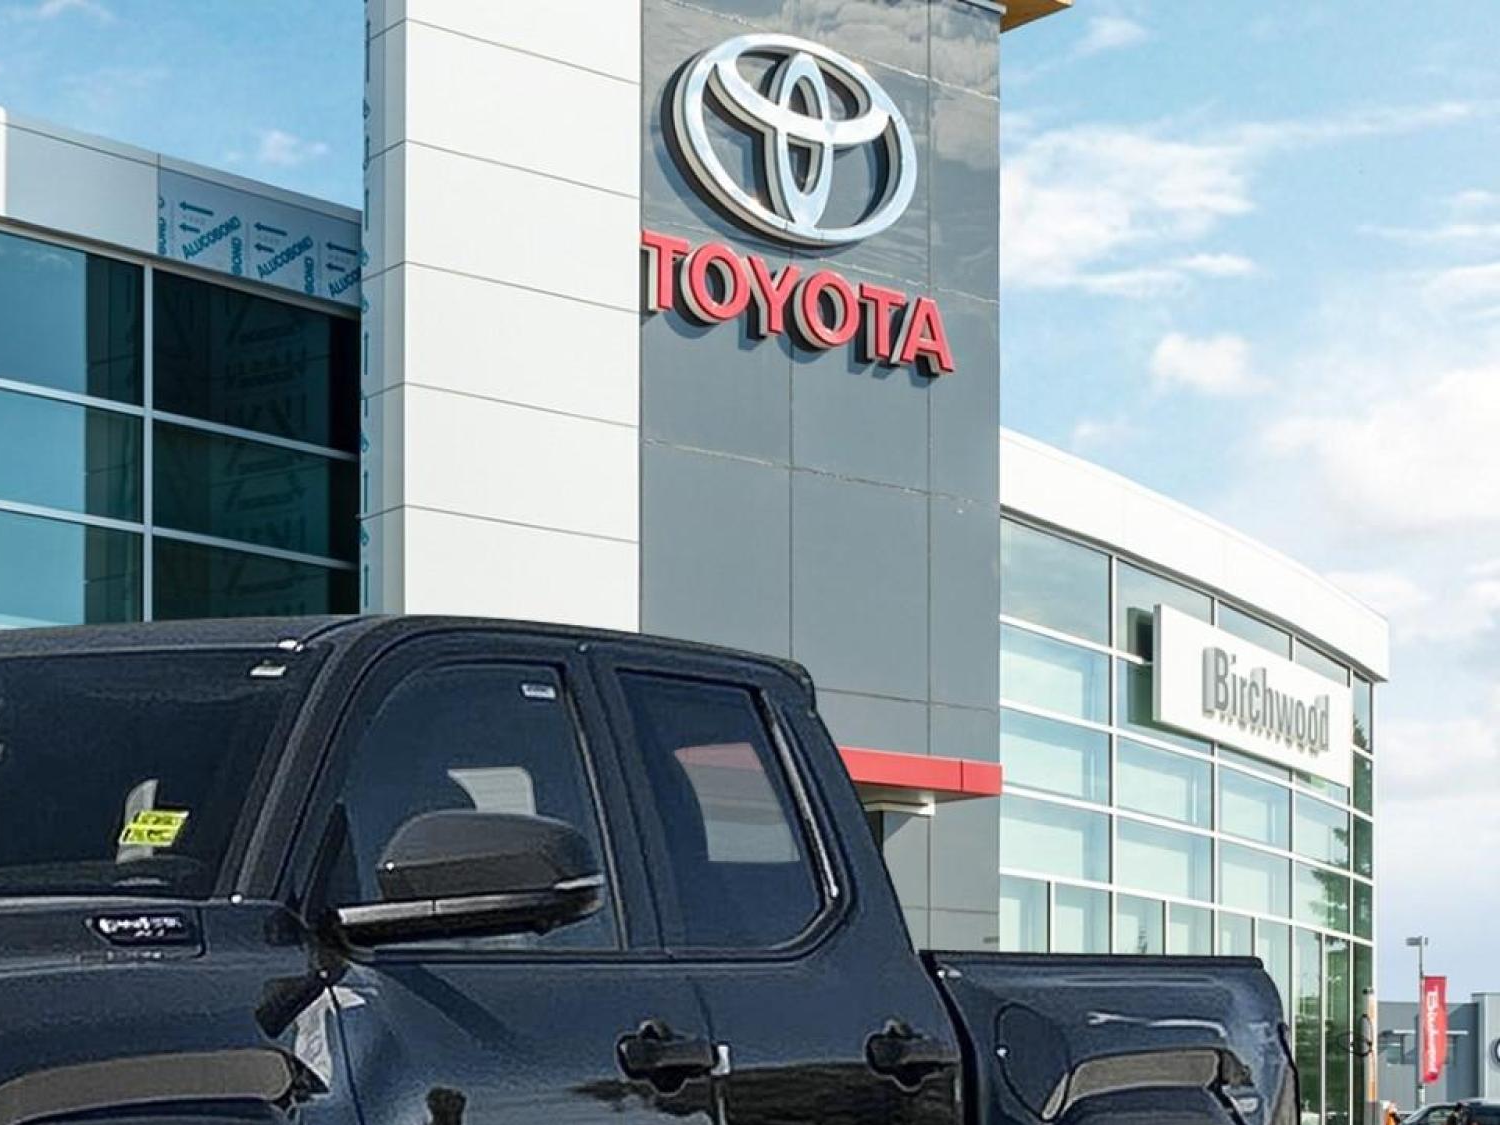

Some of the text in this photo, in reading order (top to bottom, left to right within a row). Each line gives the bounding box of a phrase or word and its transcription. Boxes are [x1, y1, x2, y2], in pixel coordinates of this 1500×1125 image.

[182, 216, 241, 259] ALUCOBOND
[258, 236, 313, 279] ALUCOBOND
[641, 230, 954, 372] TOYOTA
[1202, 647, 1329, 754] Birchwood
